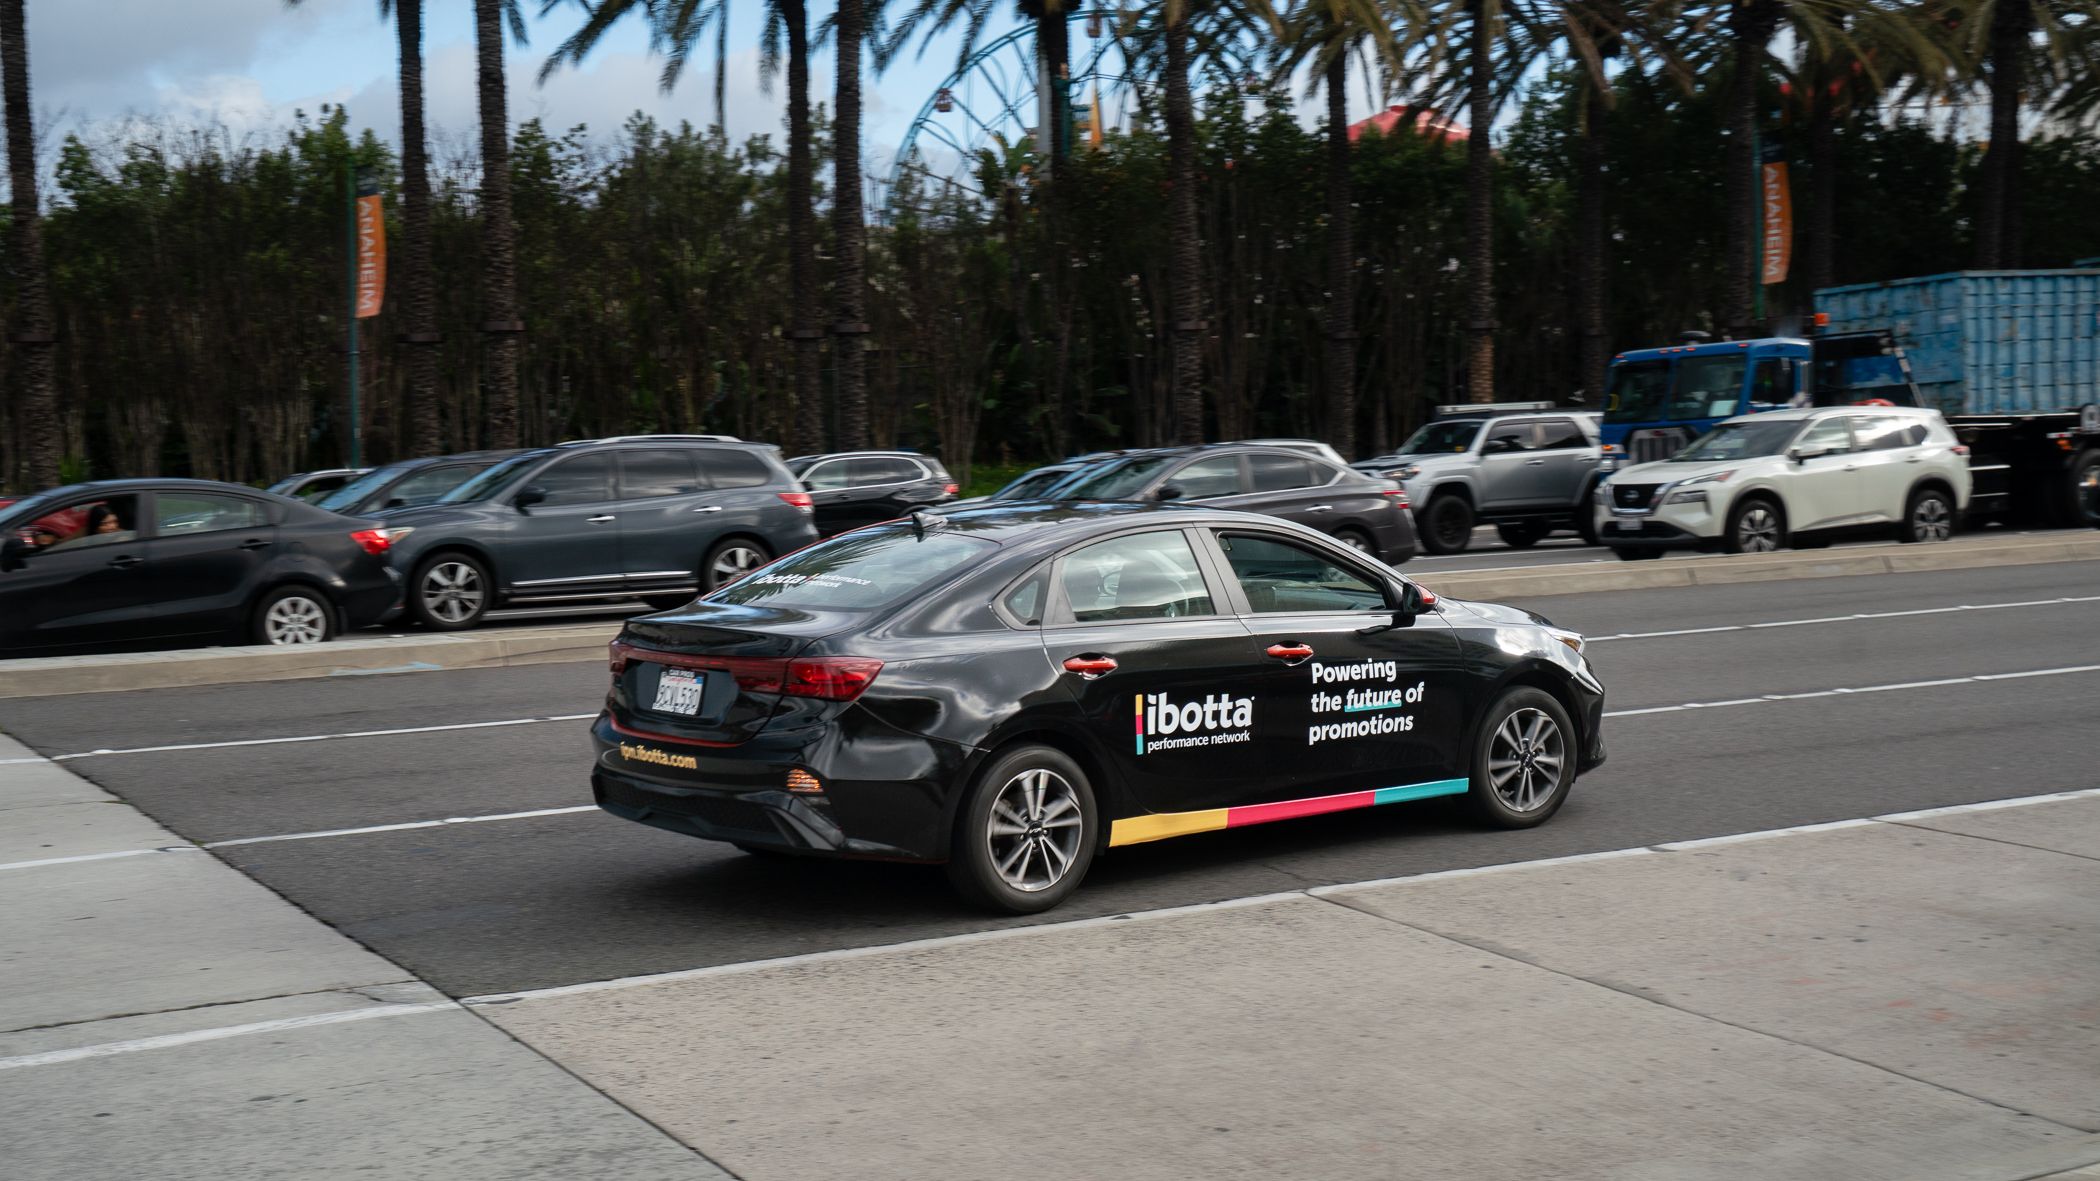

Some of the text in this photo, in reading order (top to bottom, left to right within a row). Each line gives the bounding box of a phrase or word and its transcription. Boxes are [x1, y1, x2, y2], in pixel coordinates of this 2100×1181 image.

[1764, 166, 1782, 276] ANAHEIM
[358, 200, 377, 310] ANAHEIM
[1311, 658, 1397, 684] Powering
[1311, 681, 1425, 713] the future of
[1147, 692, 1253, 736] ibotta
[1309, 714, 1414, 746] promotions
[620, 741, 697, 769] ipn.ibotta.com
[1147, 730, 1250, 754] performance network
